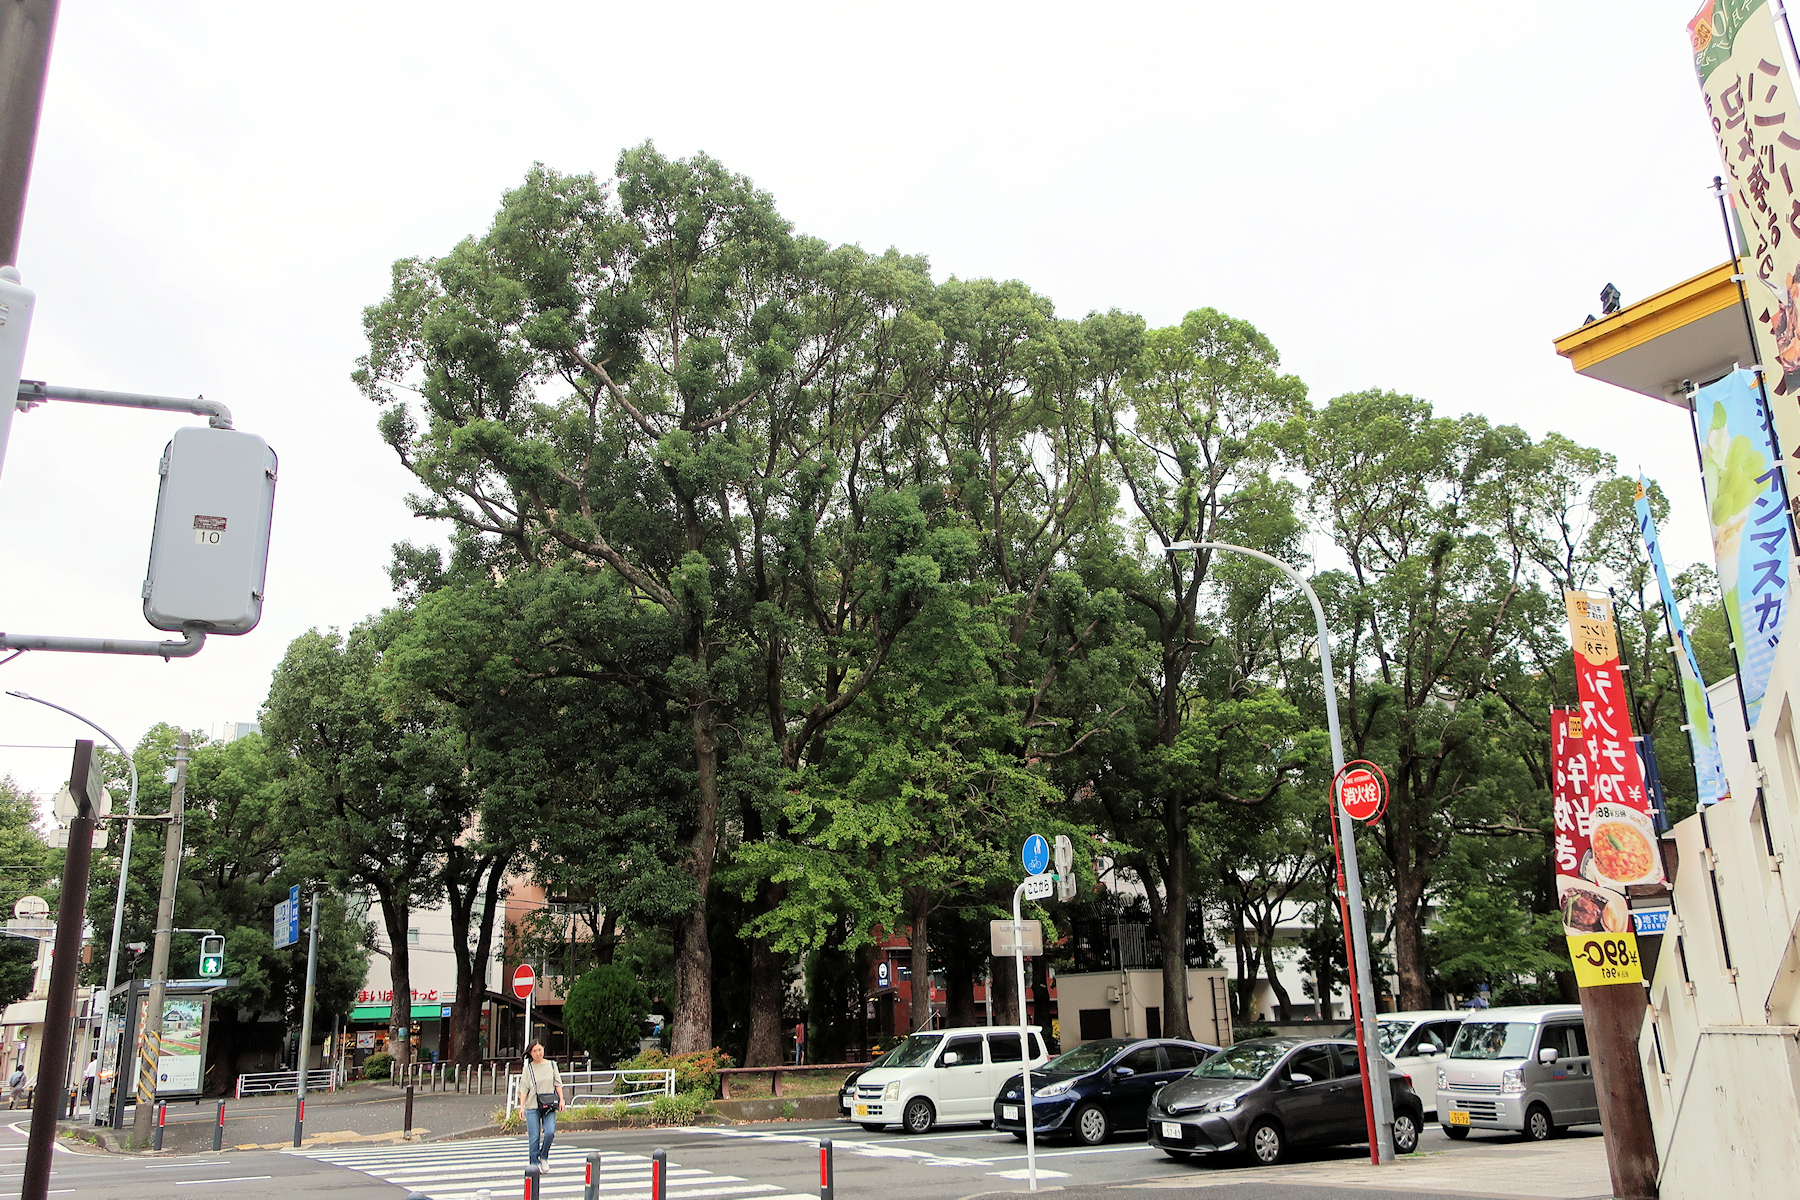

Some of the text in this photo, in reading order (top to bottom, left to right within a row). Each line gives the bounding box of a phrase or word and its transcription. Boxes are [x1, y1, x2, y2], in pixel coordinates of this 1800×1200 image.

[1750, 397, 1787, 648] シインマスカ
[201, 530, 220, 544] 10
[1343, 782, 1378, 806] 消火栓
[1028, 879, 1049, 895] ここから
[1642, 914, 1668, 924] 地下鉄
